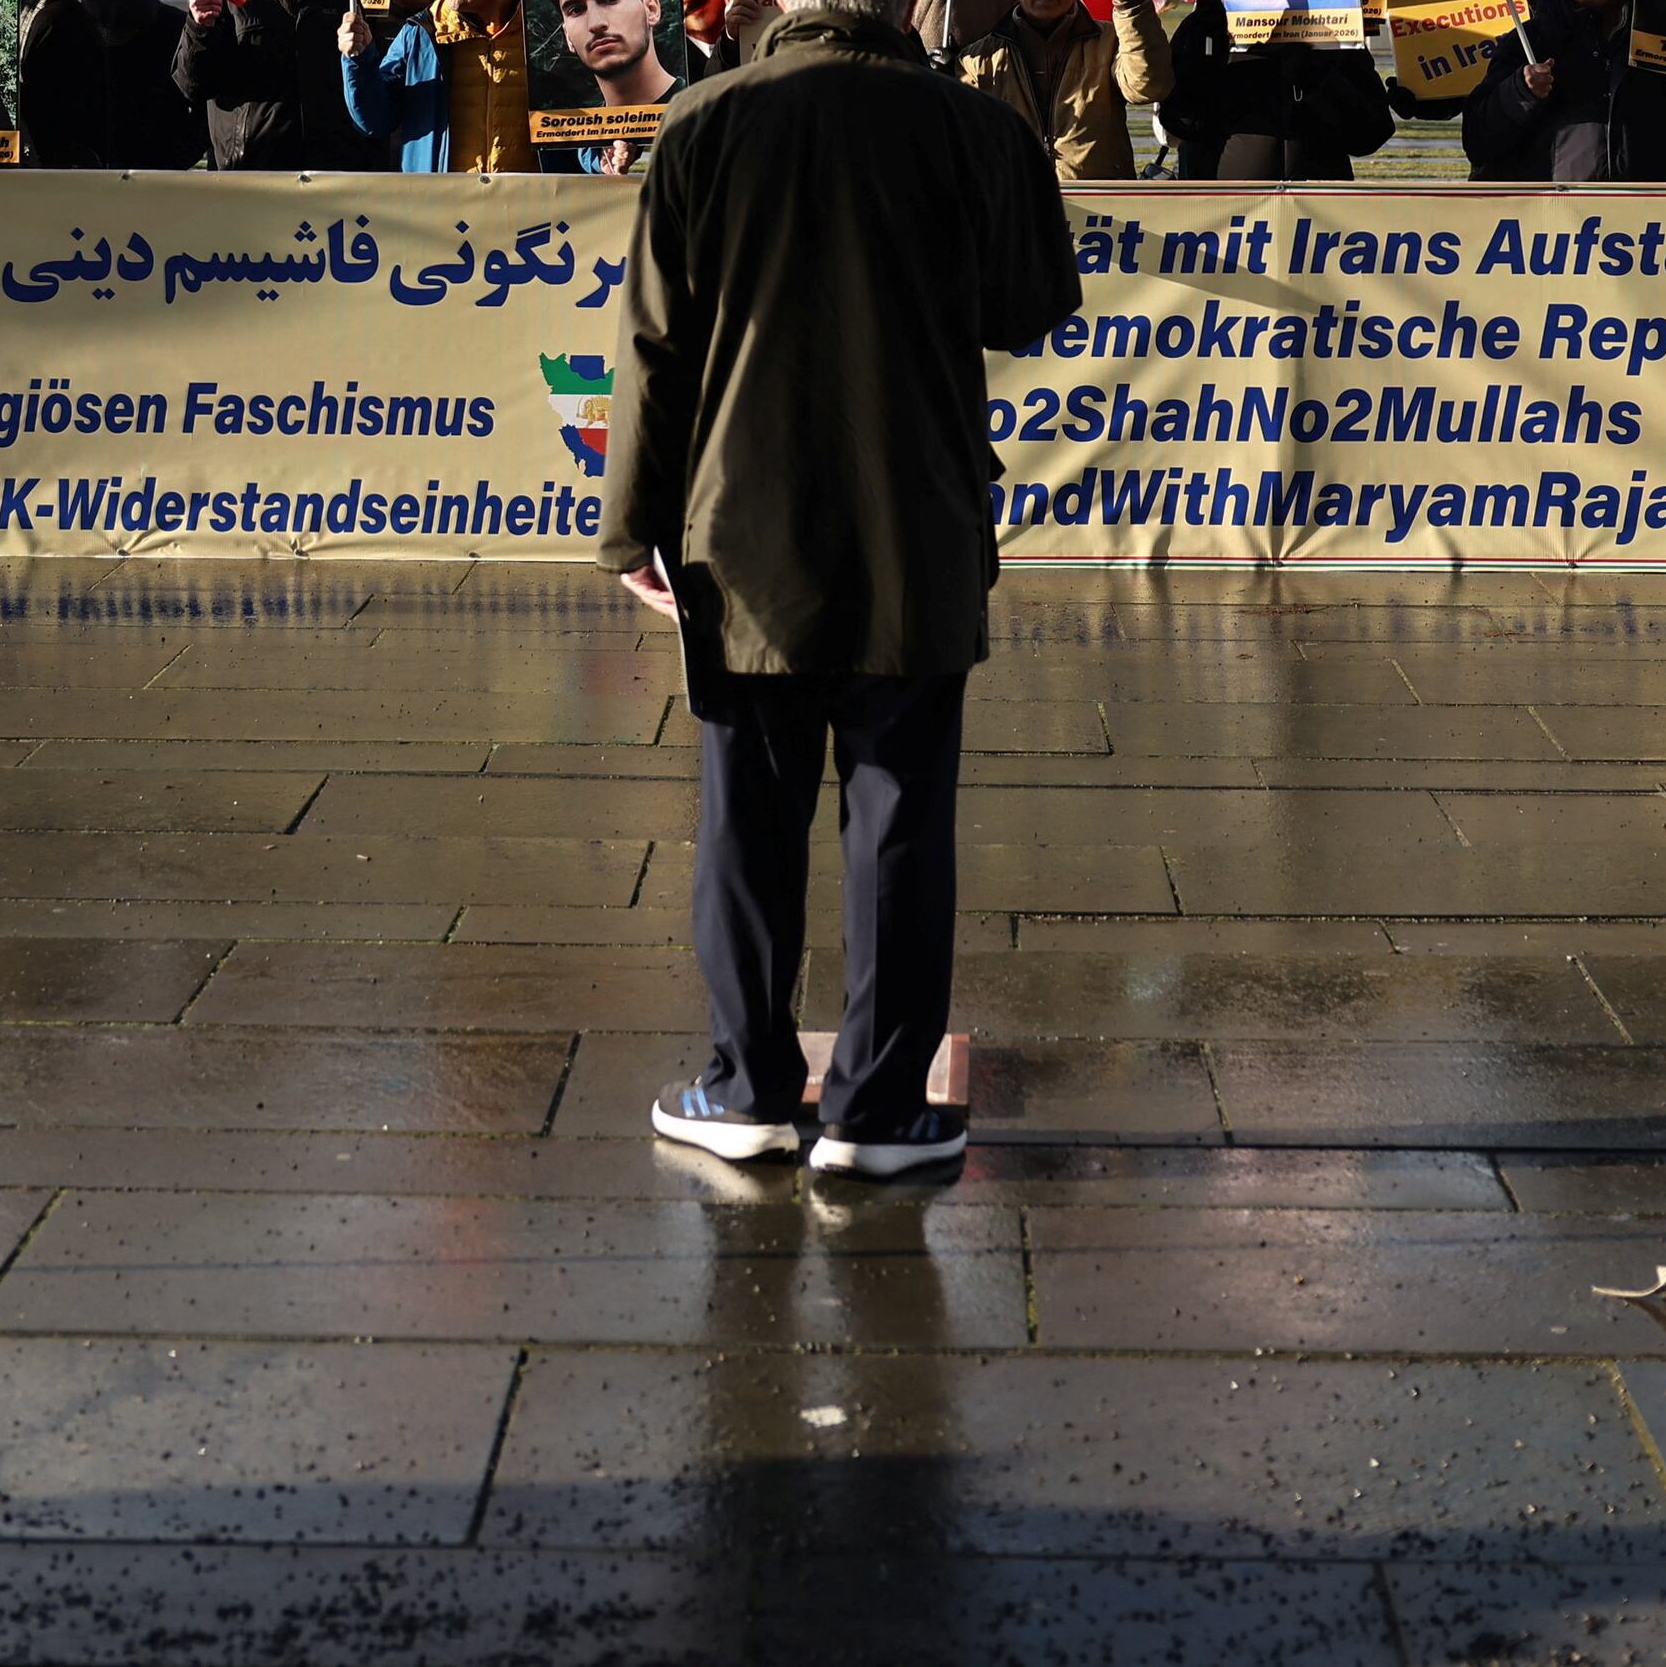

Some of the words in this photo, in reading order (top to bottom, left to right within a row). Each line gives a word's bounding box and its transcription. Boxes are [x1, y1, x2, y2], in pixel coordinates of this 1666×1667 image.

[1236, 16, 1290, 27] Mansour
[1291, 14, 1348, 26] Mokhtari
[1301, 30, 1333, 39] (Januar
[1335, 29, 1359, 38] 2026)
[1390, 0, 1526, 38] Executions
[1417, 56, 1452, 81] in
[1453, 39, 1498, 69] Ira
[536, 128, 585, 138] Ermordert
[622, 126, 657, 135] (Januar
[541, 114, 603, 127] Soroush
[607, 112, 664, 124] soleima
[1, 225, 155, 303] دینی
[164, 213, 380, 304] فاشیسم
[1156, 216, 1274, 276] mit
[1288, 217, 1464, 277] Irans
[182, 381, 496, 438] Faschismus
[987, 384, 1642, 445] o2ShahNo2Mullahs
